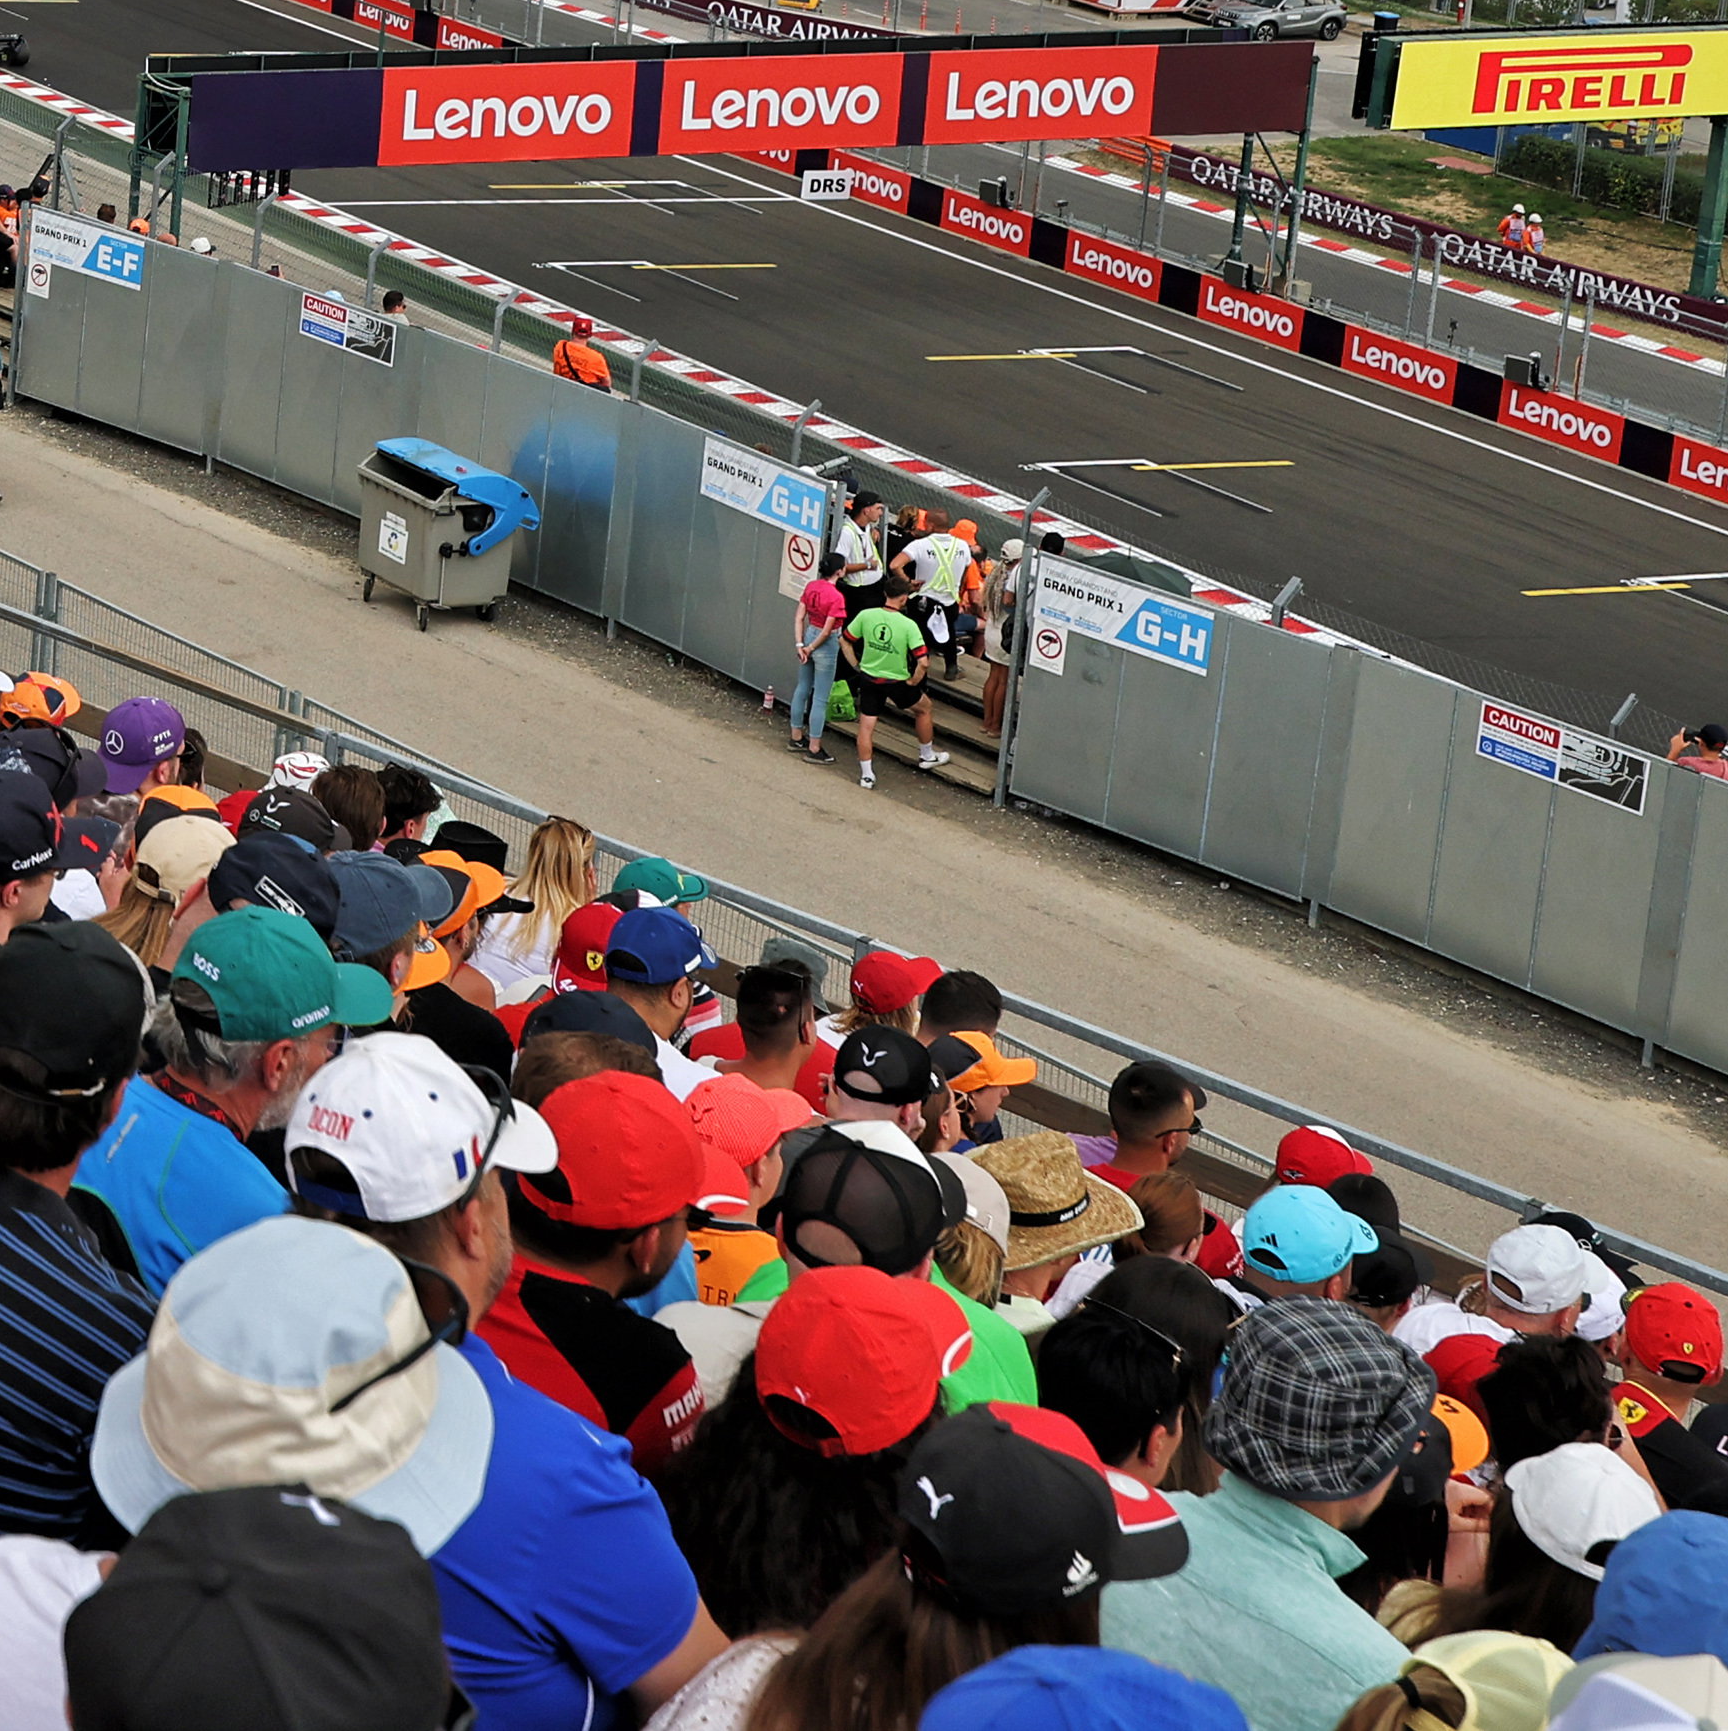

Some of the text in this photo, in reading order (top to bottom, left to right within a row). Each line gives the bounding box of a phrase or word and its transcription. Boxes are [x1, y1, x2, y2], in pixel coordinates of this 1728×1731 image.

[707, 1, 784, 38] QATAR
[946, 70, 1136, 121] Lenovo
[1472, 44, 1694, 114] PIRELLI
[403, 89, 612, 141] Lenovo
[681, 80, 881, 131] Lenovo
[809, 177, 846, 193] DRS
[34, 225, 62, 241] GRAND
[63, 233, 81, 248] PRIX
[948, 205, 1023, 245] Lenovo
[96, 244, 141, 277] E-F
[1073, 239, 1154, 288] Lenovo
[1442, 233, 1683, 323] QATAR AIRWAYS
[306, 298, 344, 321] CAUTION
[1205, 285, 1295, 337] Lenovo
[1350, 334, 1446, 390] Lenovo
[1508, 389, 1612, 447] Lenovo
[707, 457, 735, 476] GRAND
[737, 468, 756, 486] PRIX
[771, 484, 821, 530] G-H
[1043, 577, 1114, 611] GRAND PRIX
[1160, 605, 1188, 620] SECTOR
[1136, 610, 1207, 662] G-H
[1488, 710, 1555, 745] CAUTION
[12, 848, 53, 872] CarNext
[192, 952, 221, 983] BOSS
[307, 1105, 355, 1142] OCON
